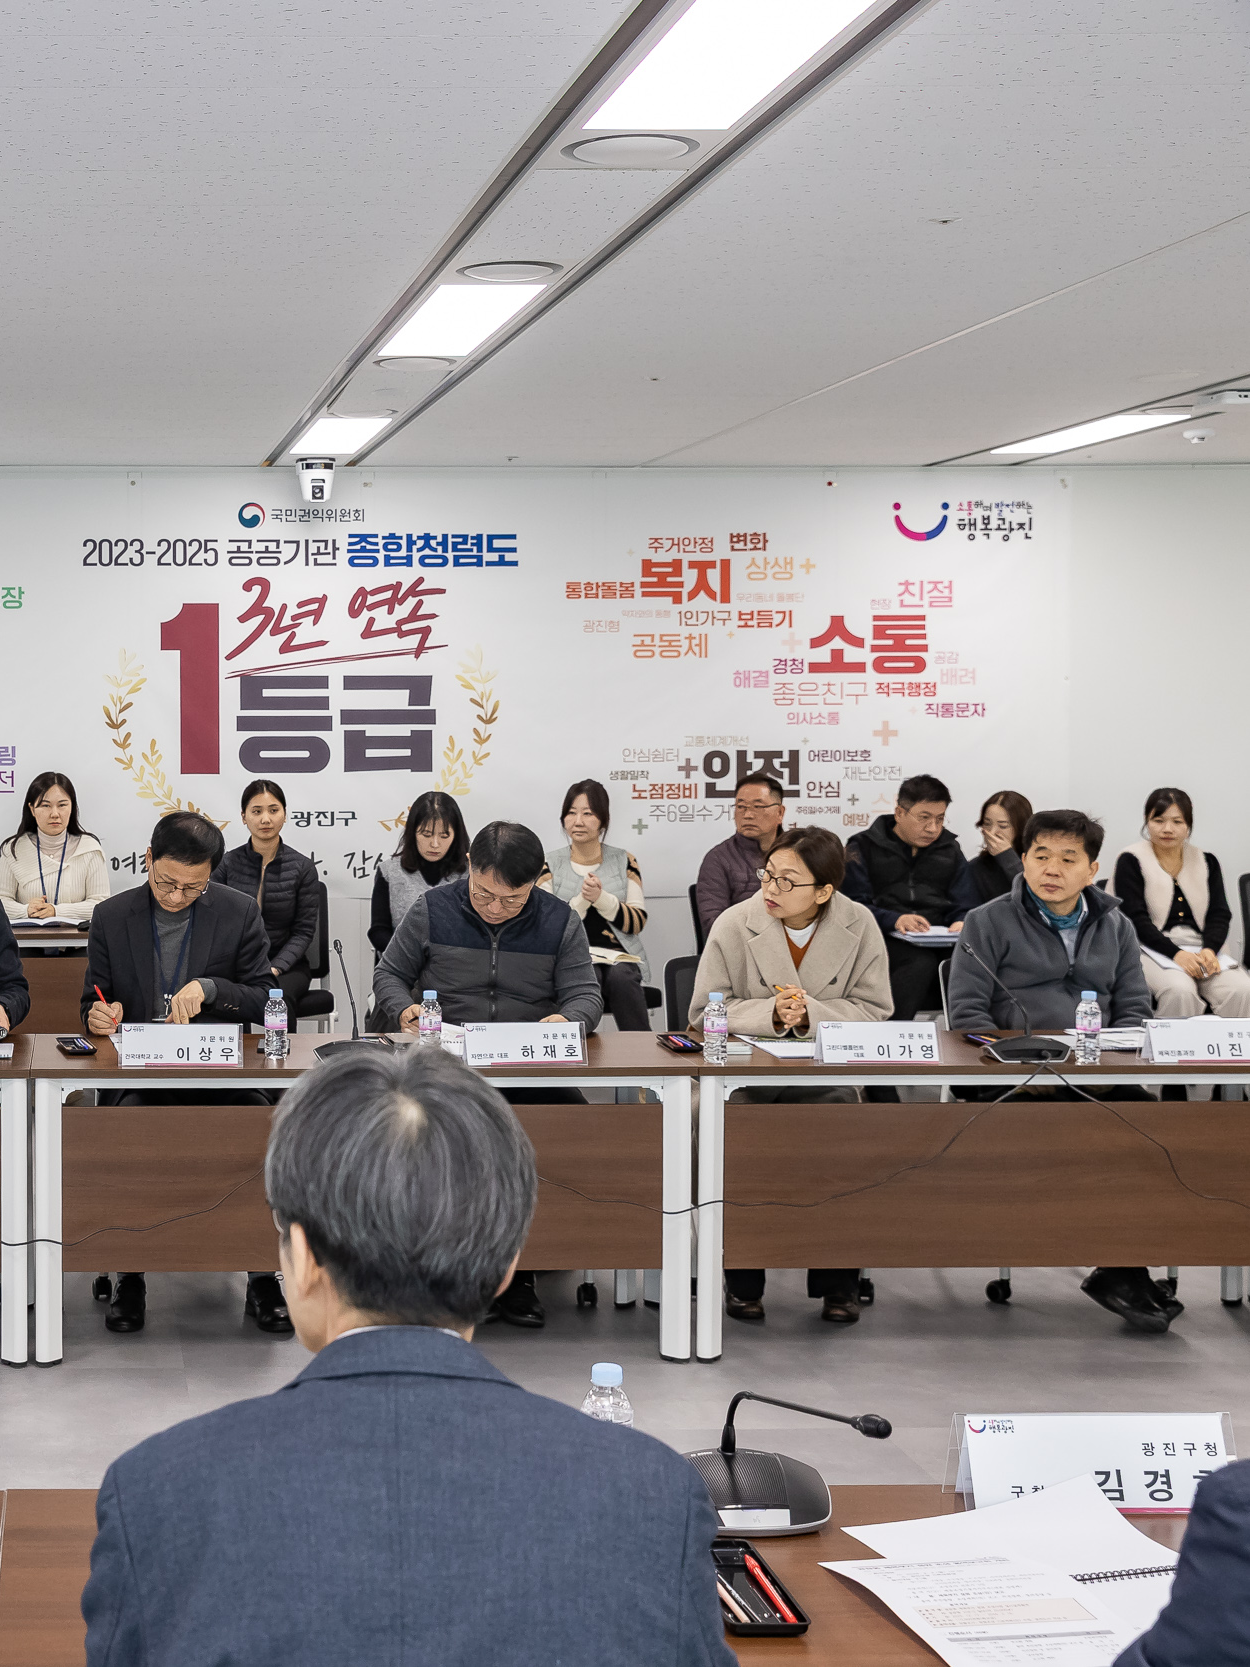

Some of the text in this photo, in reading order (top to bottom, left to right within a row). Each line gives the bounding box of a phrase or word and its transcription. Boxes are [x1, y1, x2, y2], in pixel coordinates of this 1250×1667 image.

[271, 508, 365, 524] 국민권익위원회
[956, 514, 1033, 542] 행복광진
[82, 533, 519, 567] 2023-2025 공공기관 종합청렴도
[648, 537, 715, 554] 주거안정
[728, 532, 769, 552] 변화
[745, 556, 794, 581] 상생
[565, 581, 636, 599] 통합돌봄
[640, 558, 731, 604] 복지
[897, 580, 953, 608] 친절
[224, 576, 448, 661] 3년 연속
[582, 620, 620, 633] 광진형
[677, 610, 793, 628] 1인가구 보듬기
[632, 633, 708, 659] 공동체
[808, 615, 928, 674] 소통
[772, 658, 804, 675] 경청
[733, 669, 770, 688] 해결
[940, 668, 976, 686] 배려
[772, 682, 868, 706] 좋은친구
[875, 682, 937, 697] 적극행정
[786, 712, 839, 725] 의사소통
[924, 703, 986, 718] 직통문자
[622, 748, 680, 763] 안심쉼터
[808, 749, 872, 762] 어린이보호
[609, 770, 649, 780] 생활밀착
[842, 766, 902, 781] 재난안전
[631, 783, 698, 800] 노점정비
[806, 781, 840, 799] 안심
[291, 810, 358, 828] 광진구
[649, 804, 735, 822] 주6일수거
[842, 813, 870, 827] 예방
[176, 1047, 235, 1062] 이상우
[521, 1045, 579, 1060] 하재호
[877, 1044, 934, 1059] 이가영
[1141, 1442, 1218, 1457] 광진구청
[1094, 1469, 1212, 1502] 김경
